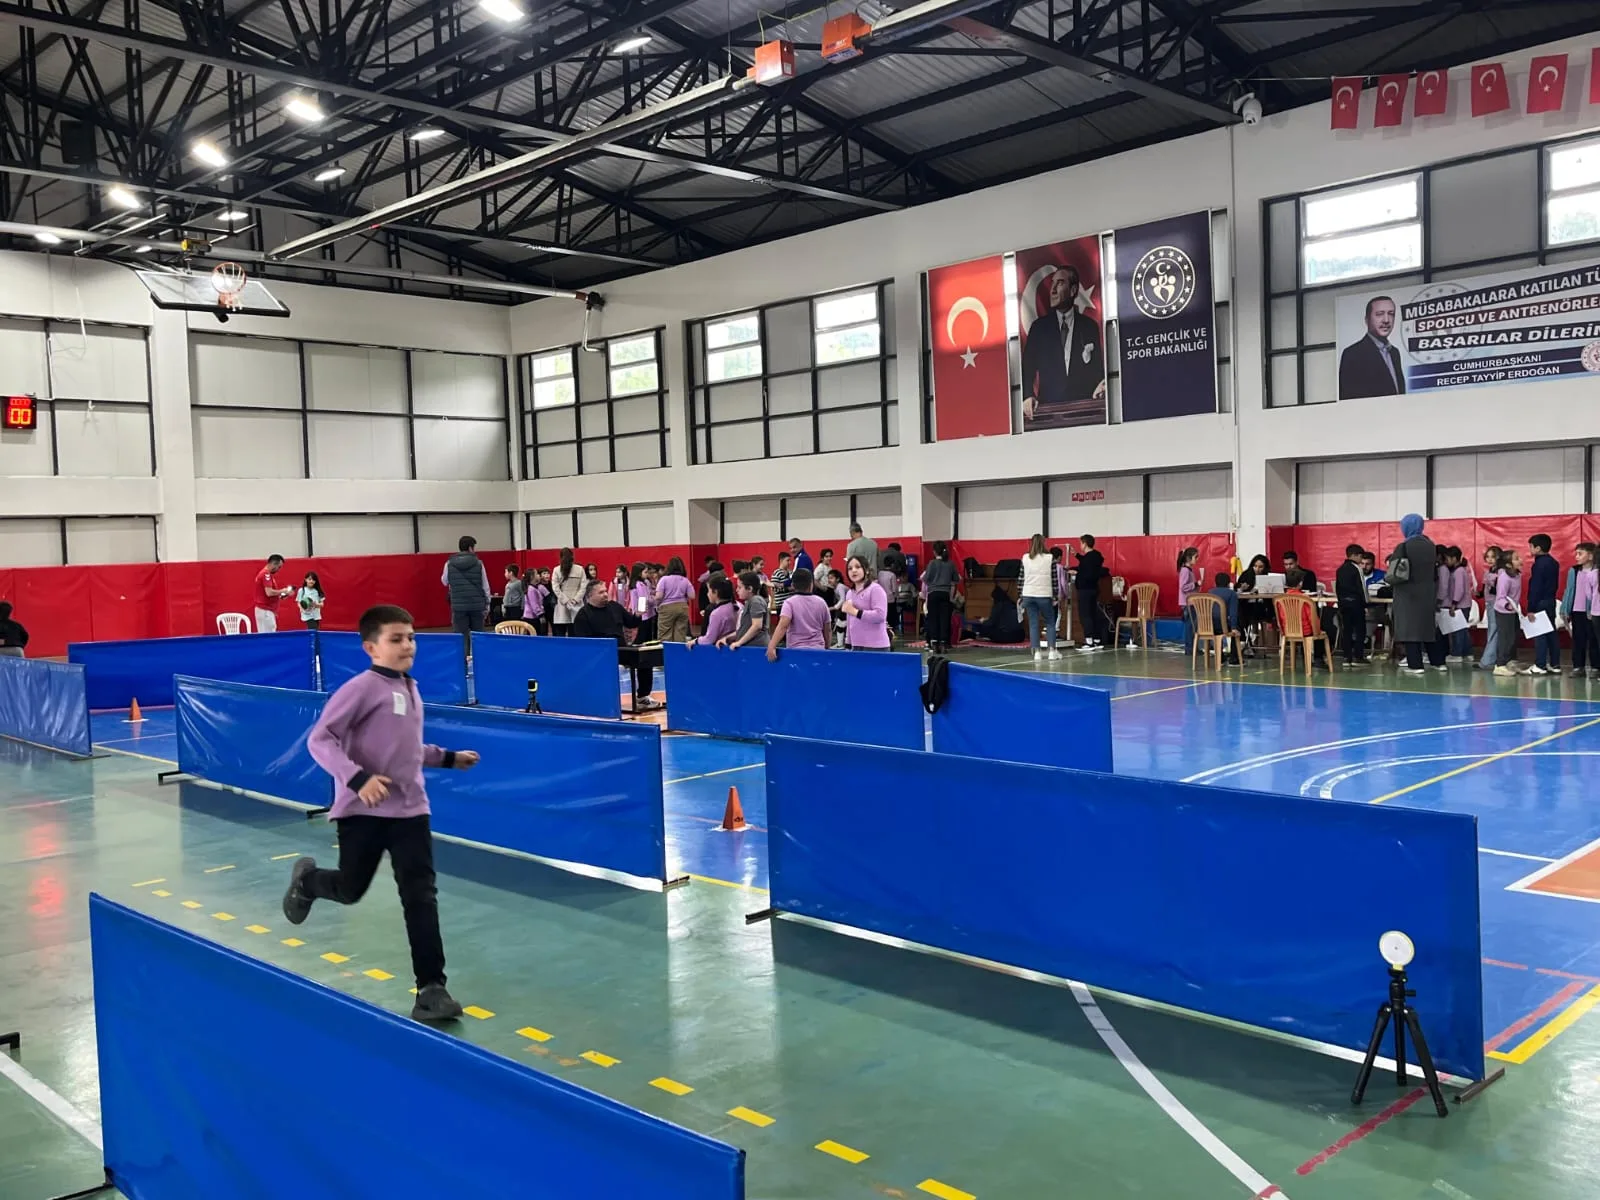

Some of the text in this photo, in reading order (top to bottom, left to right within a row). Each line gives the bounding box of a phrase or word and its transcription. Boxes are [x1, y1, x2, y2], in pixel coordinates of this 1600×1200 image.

[1405, 287, 1518, 319] MÜSABAKALARA
[1520, 273, 1582, 296] KATILAN
[1418, 296, 1600, 331] SPORCU VE ANTRENÖRLE
[1126, 327, 1207, 347] T.C. GENÇLİK VE
[1418, 331, 1523, 350] BAŞARILAR
[1127, 339, 1207, 360] SPOR BAKANLIĞI
[1453, 355, 1542, 371] CUMHURBAŞKANI
[1436, 366, 1560, 386] RECEP TAYYİP ERDOĞAN
[10, 408, 32, 425] 00
